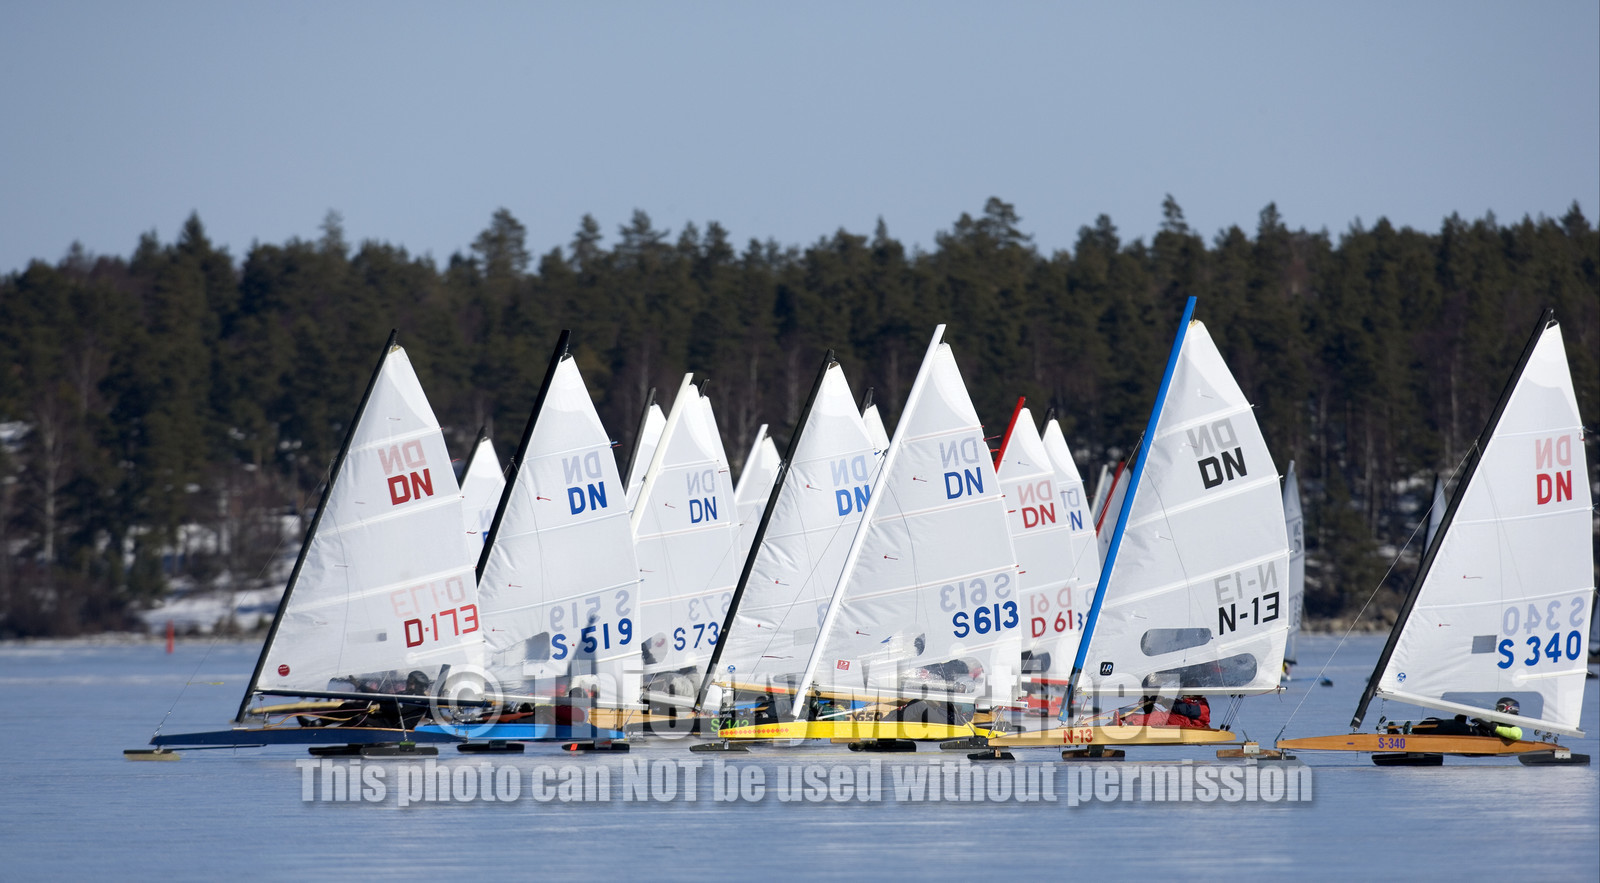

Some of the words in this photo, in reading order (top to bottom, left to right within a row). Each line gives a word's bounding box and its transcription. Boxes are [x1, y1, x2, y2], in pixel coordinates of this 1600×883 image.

[944, 466, 984, 499] DN
[1197, 446, 1247, 489] DN
[387, 468, 434, 505] DN
[567, 481, 608, 515] DN
[835, 484, 871, 516] DN
[1536, 470, 1572, 505] DN
[688, 496, 718, 523] DN
[1021, 502, 1056, 528] DN
[1031, 616, 1046, 638] D
[1054, 609, 1073, 633] 61
[1218, 591, 1280, 636] N-13
[551, 633, 568, 660] S
[580, 617, 633, 653] 519
[673, 627, 686, 651] S
[693, 621, 720, 649] 73
[1497, 638, 1514, 669] S
[1524, 630, 1581, 667] 340
[1063, 728, 1093, 743] N-13
[1378, 737, 1406, 749] S-340
